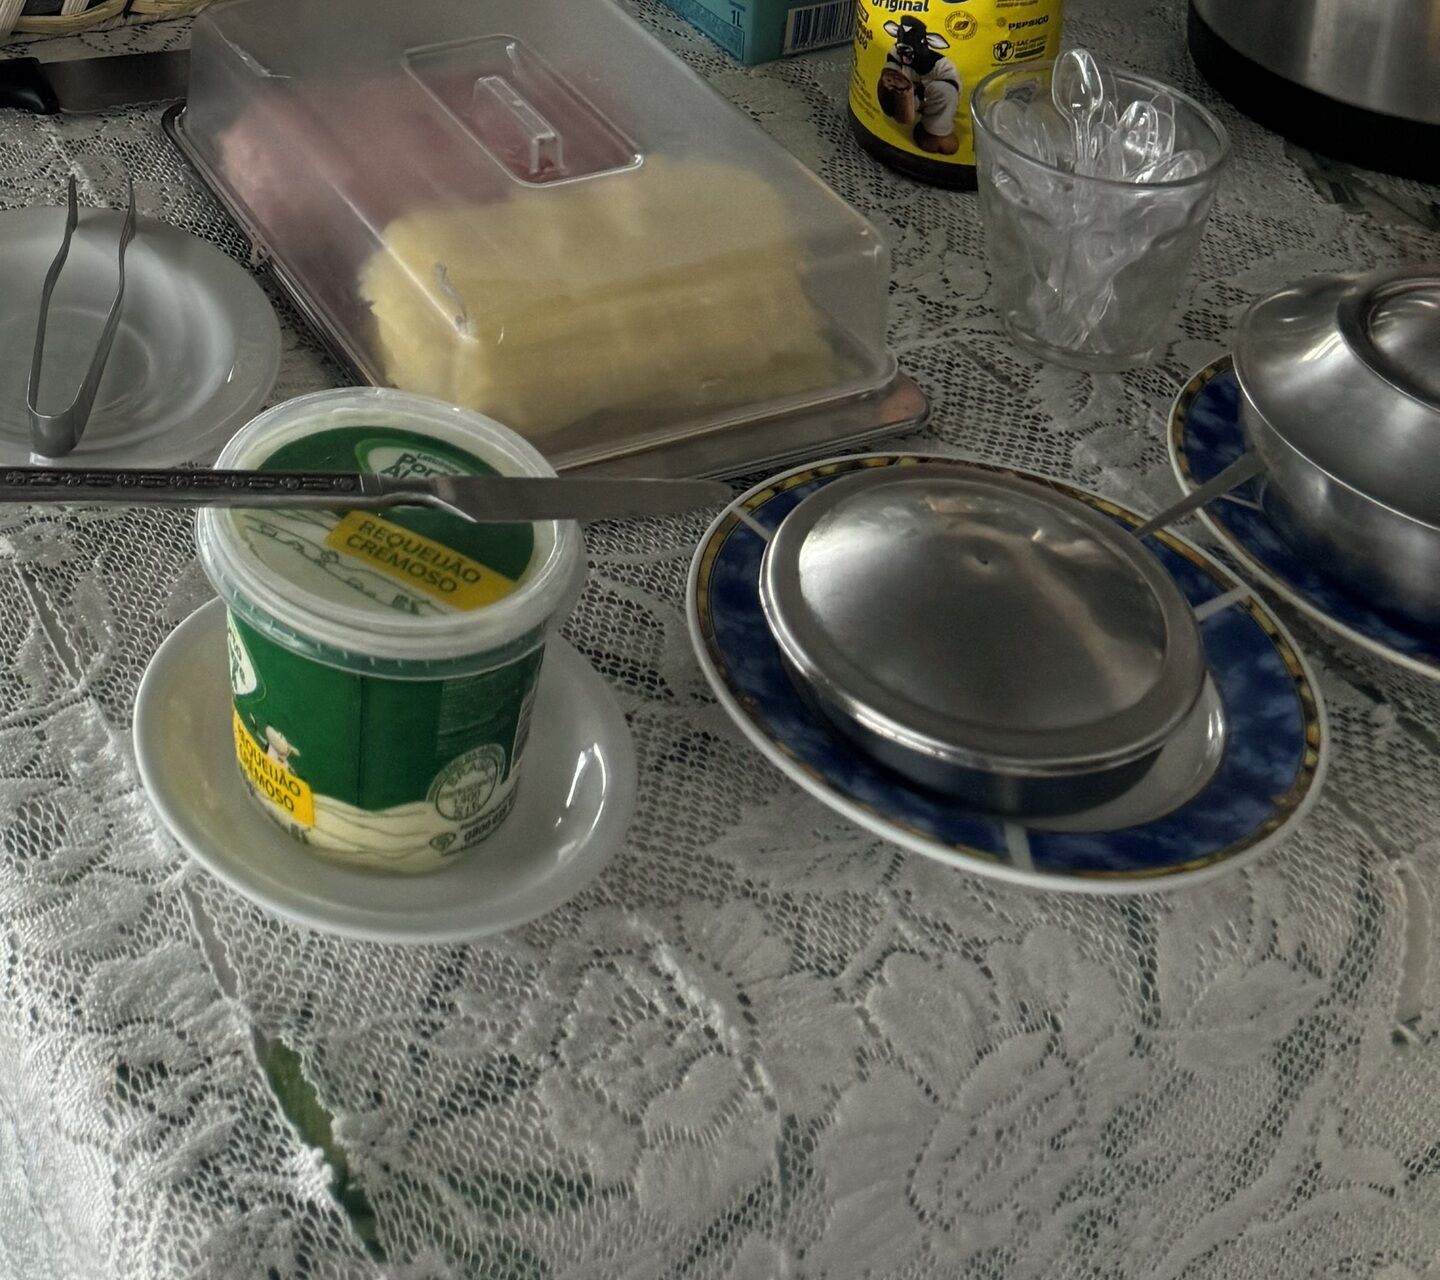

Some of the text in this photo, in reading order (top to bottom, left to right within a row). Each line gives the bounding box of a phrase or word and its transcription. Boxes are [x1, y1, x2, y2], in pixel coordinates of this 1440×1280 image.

[730, 10, 743, 28] 1L
[1008, 15, 1050, 31] PEPSICO
[346, 534, 458, 593] CREMOSO
[358, 520, 482, 584] REQUEIJÃO
